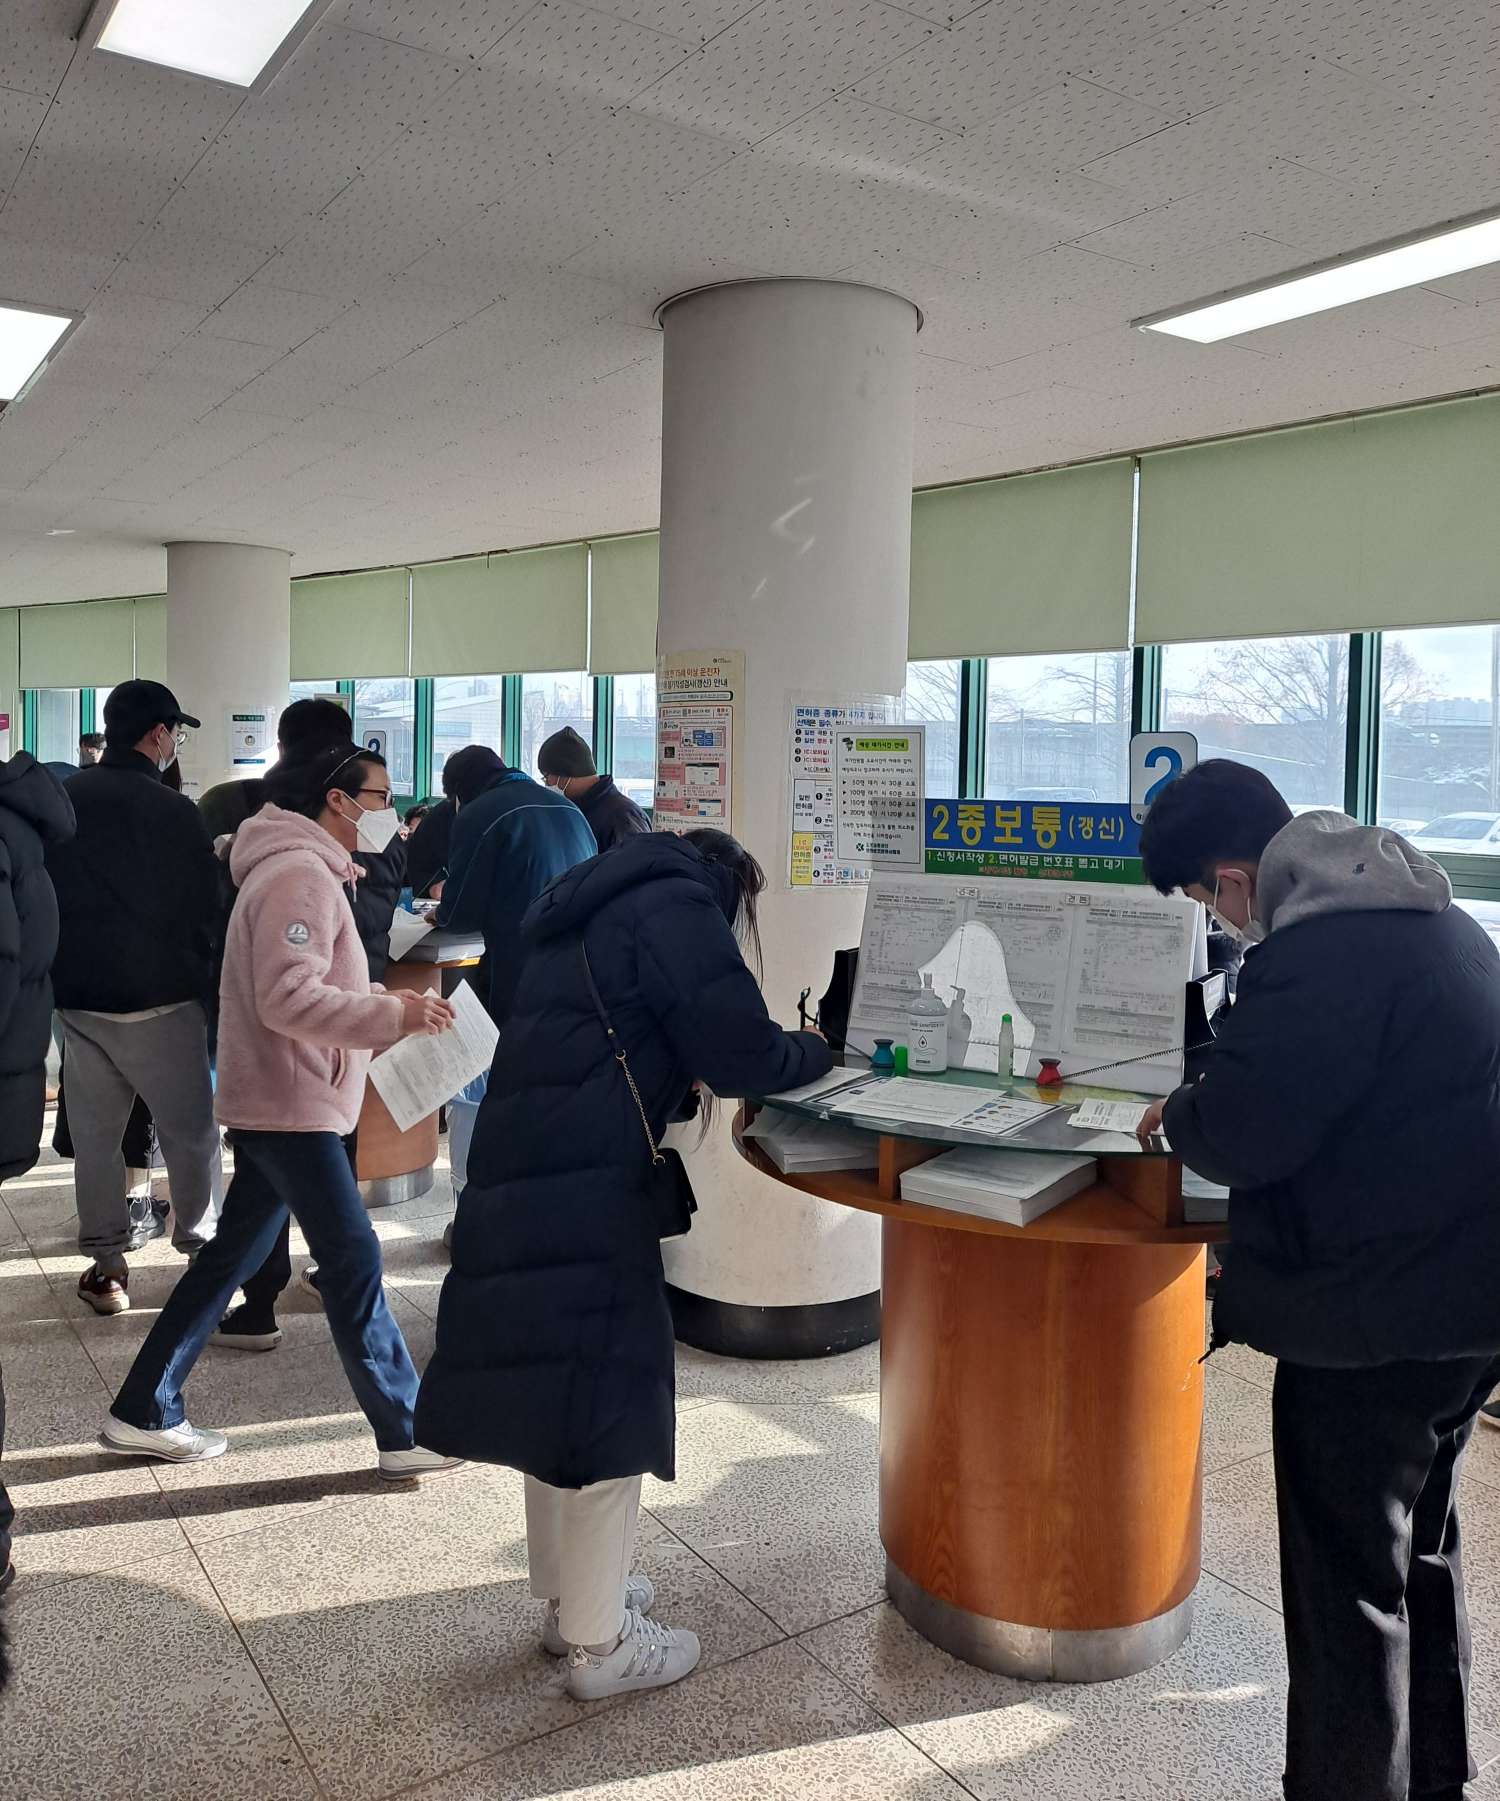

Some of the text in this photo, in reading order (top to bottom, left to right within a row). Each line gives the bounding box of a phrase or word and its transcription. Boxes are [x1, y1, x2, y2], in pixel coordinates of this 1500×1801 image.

[797, 708, 820, 718] 면허증
[1144, 746, 1182, 806] 2
[1069, 816, 1124, 842] (갱신)
[1044, 856, 1073, 868] 번호표
[1079, 858, 1099, 869] 뽑고
[1104, 858, 1124, 870] 대기
